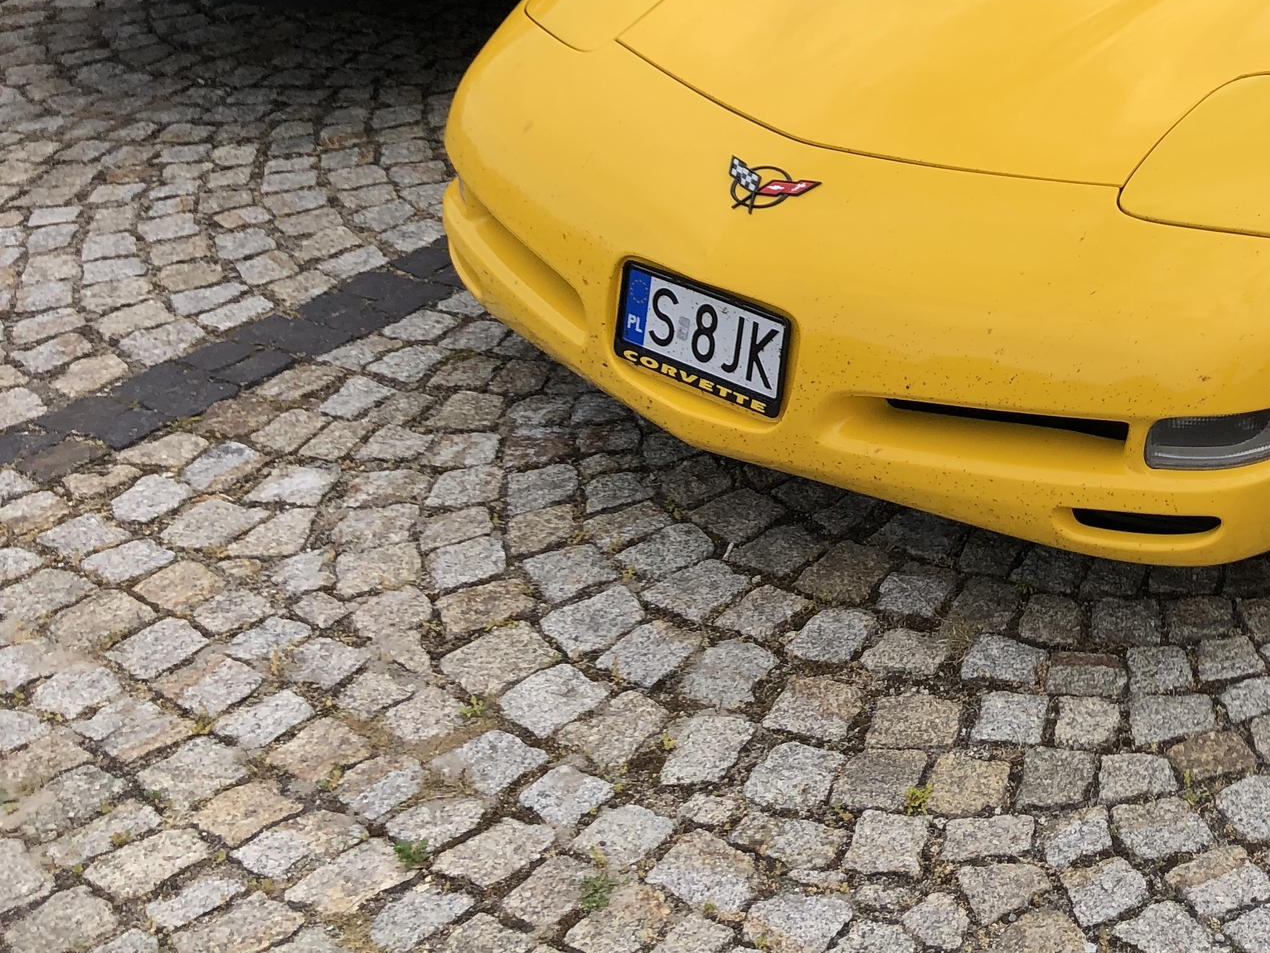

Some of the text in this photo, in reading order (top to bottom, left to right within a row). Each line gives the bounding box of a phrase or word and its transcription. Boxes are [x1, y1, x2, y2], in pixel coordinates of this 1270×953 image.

[626, 313, 643, 333] PL
[649, 288, 780, 390] S 8JK
[622, 350, 767, 413] CORVETTE
